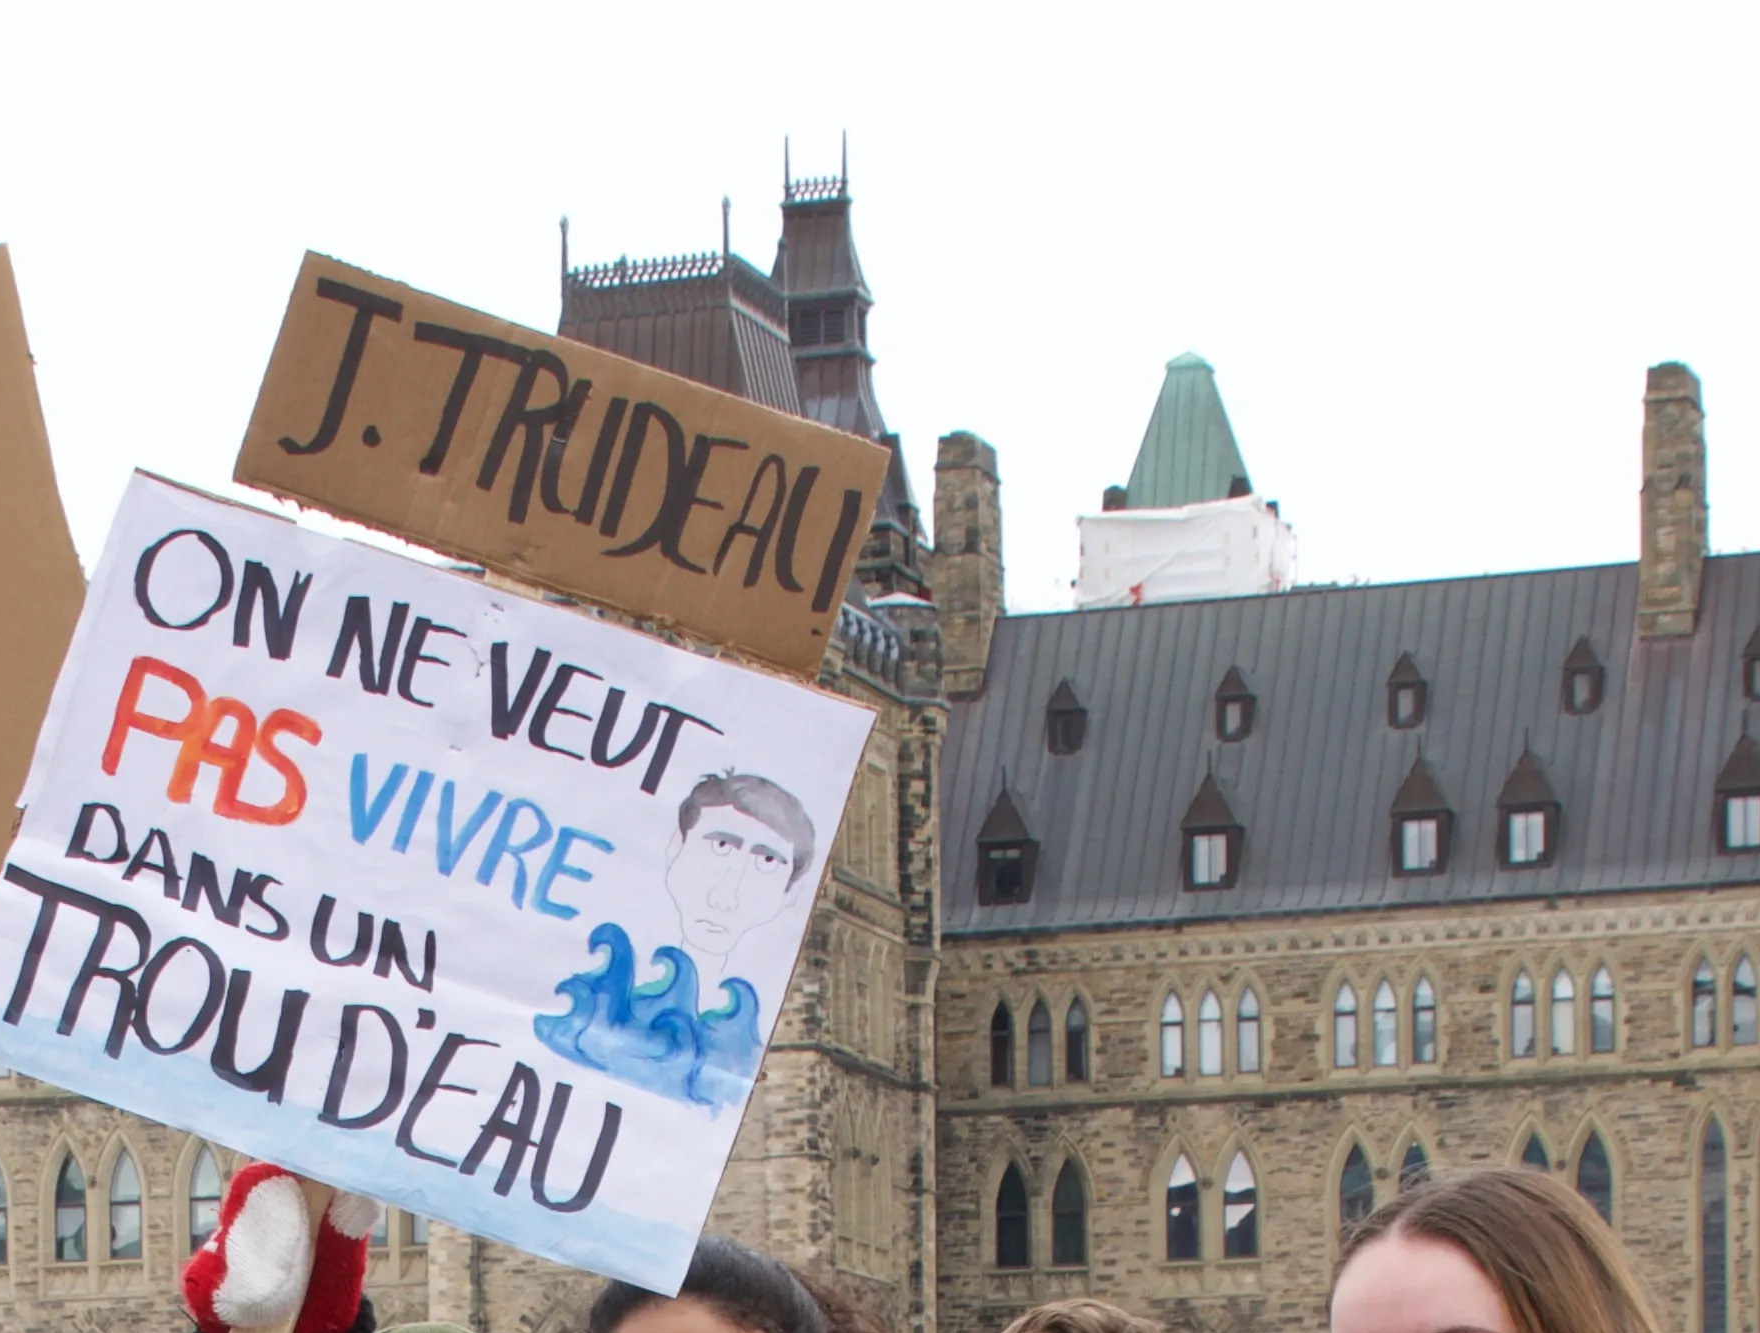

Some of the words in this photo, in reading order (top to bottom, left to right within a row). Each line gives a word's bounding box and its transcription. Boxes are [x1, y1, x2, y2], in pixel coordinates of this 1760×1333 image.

[278, 276, 404, 456] J.
[100, 655, 323, 828] PAS
[348, 751, 615, 923] VIVRE
[135, 528, 314, 661] ON
[325, 596, 467, 707] NE
[488, 640, 725, 796] VEUT
[65, 803, 290, 942] DANS
[311, 894, 437, 992] UN
[1, 862, 312, 1105] TROU
[317, 1005, 621, 1214] D'EAU
